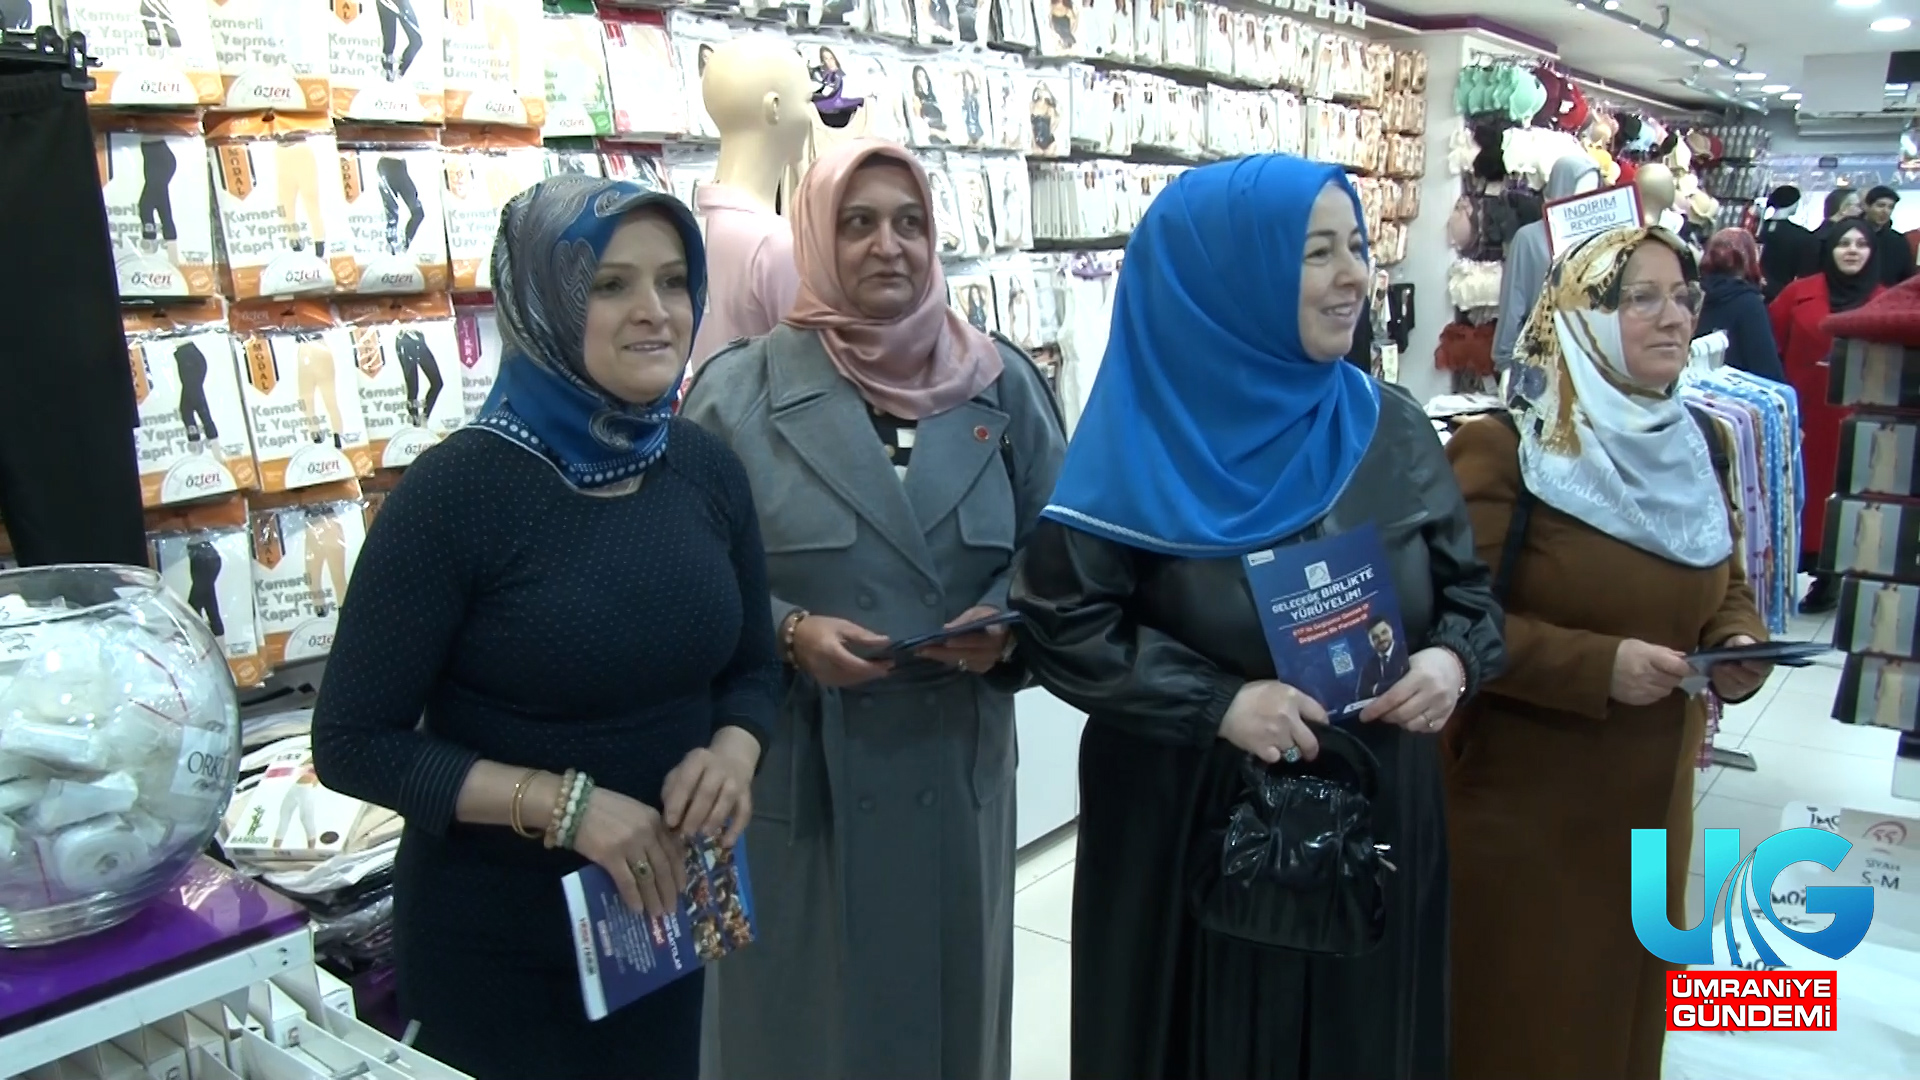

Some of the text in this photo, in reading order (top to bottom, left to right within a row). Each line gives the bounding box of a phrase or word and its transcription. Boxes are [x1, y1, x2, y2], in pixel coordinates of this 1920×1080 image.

[209, 17, 264, 30] emerli
[216, 51, 247, 65] apri
[140, 80, 180, 94] özten
[253, 85, 291, 98] özten
[375, 99, 408, 112] özten
[485, 101, 515, 114] özten
[341, 162, 354, 200] ODAL
[1563, 195, 1617, 219] İNDİRİM
[1570, 212, 1617, 231] REYONU
[131, 271, 173, 288] özten
[285, 269, 321, 283] özten
[381, 272, 414, 285] özten
[252, 343, 269, 390] MODAL
[251, 399, 308, 418] Kemerli
[270, 414, 327, 435] Yapmaz
[258, 432, 297, 450] Kapri
[308, 459, 341, 475] özten
[185, 472, 220, 489] özten
[1320, 567, 1375, 599] BİRLİKTE
[1290, 587, 1363, 621] YÜRÜYELİM!
[308, 635, 334, 648] özte
[1861, 870, 1900, 890] S-M
